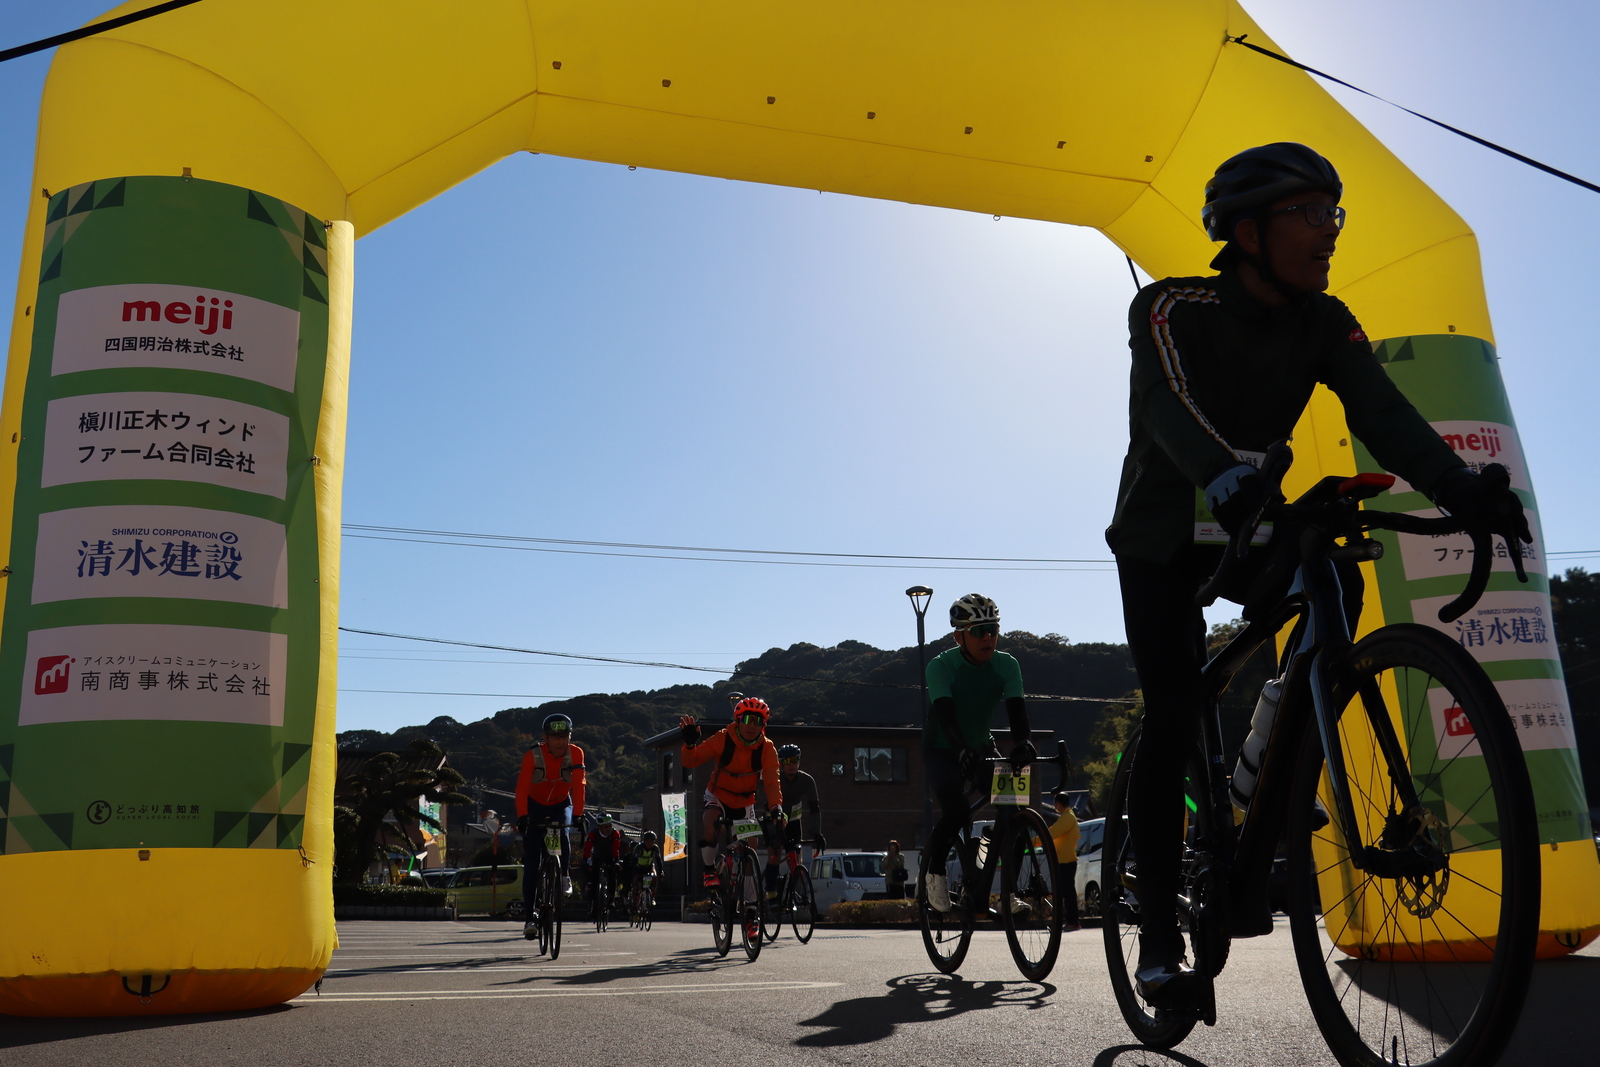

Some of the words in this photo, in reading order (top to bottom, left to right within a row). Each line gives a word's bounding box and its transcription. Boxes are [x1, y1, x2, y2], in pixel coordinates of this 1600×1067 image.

[121, 295, 233, 335] meiji
[104, 336, 244, 361] 四国明治株式会社
[1442, 427, 1502, 458] meiji
[78, 441, 256, 474] ファーム合同会社
[111, 528, 150, 536] SHIMIZU
[152, 528, 218, 540] CORPORATION
[76, 539, 243, 581] 清水建設
[1455, 616, 1549, 648] 清水建設
[83, 655, 261, 671] アイスクリームコミュニケーション
[80, 669, 271, 697] 南商事株式会社
[997, 776, 1026, 791] 015
[116, 804, 200, 814] どっぷり高知旅
[738, 824, 758, 832] 017
